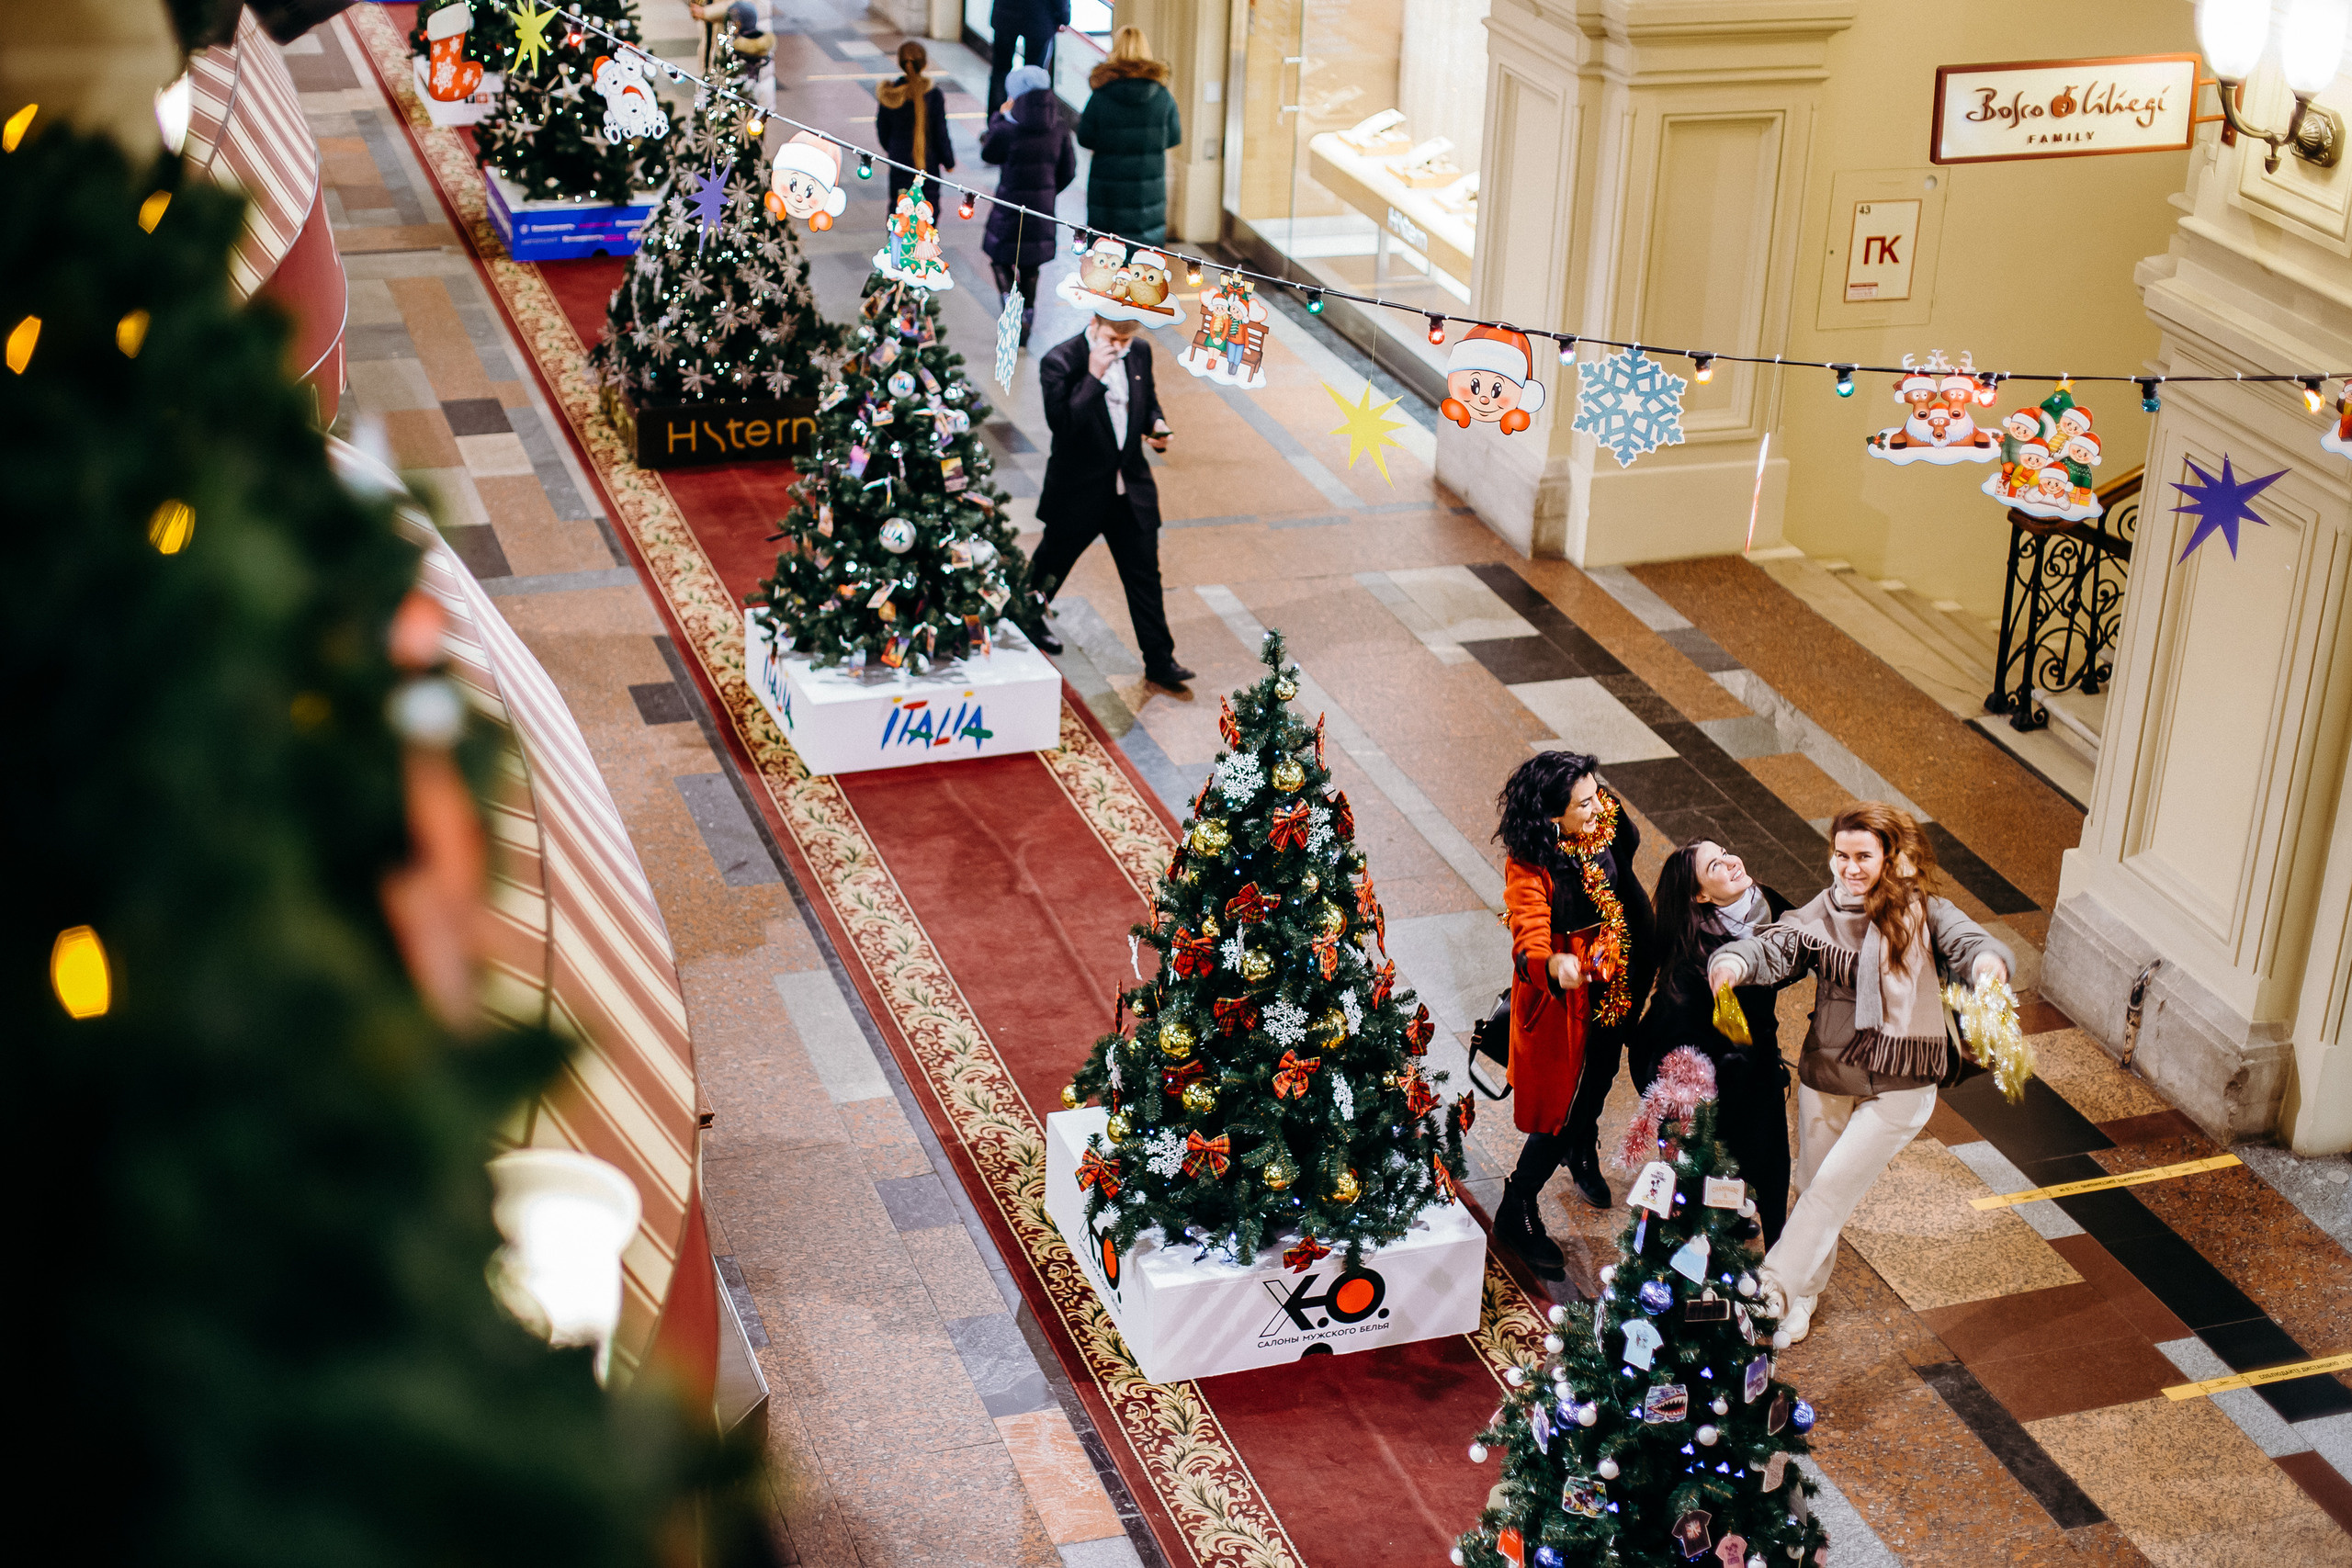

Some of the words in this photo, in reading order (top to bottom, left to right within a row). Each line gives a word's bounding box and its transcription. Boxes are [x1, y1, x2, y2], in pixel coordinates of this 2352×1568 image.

[1965, 86, 2045, 130] Bosco
[2028, 130, 2096, 144] FAMILY
[1863, 234, 1903, 265] ПК
[880, 691, 994, 751] ITALIA
[1257, 1337, 1299, 1348] САЛОНЫ
[1302, 1327, 1357, 1342] МУЖСКОГО
[1359, 1322, 1390, 1333] БЕЛЬЯ
